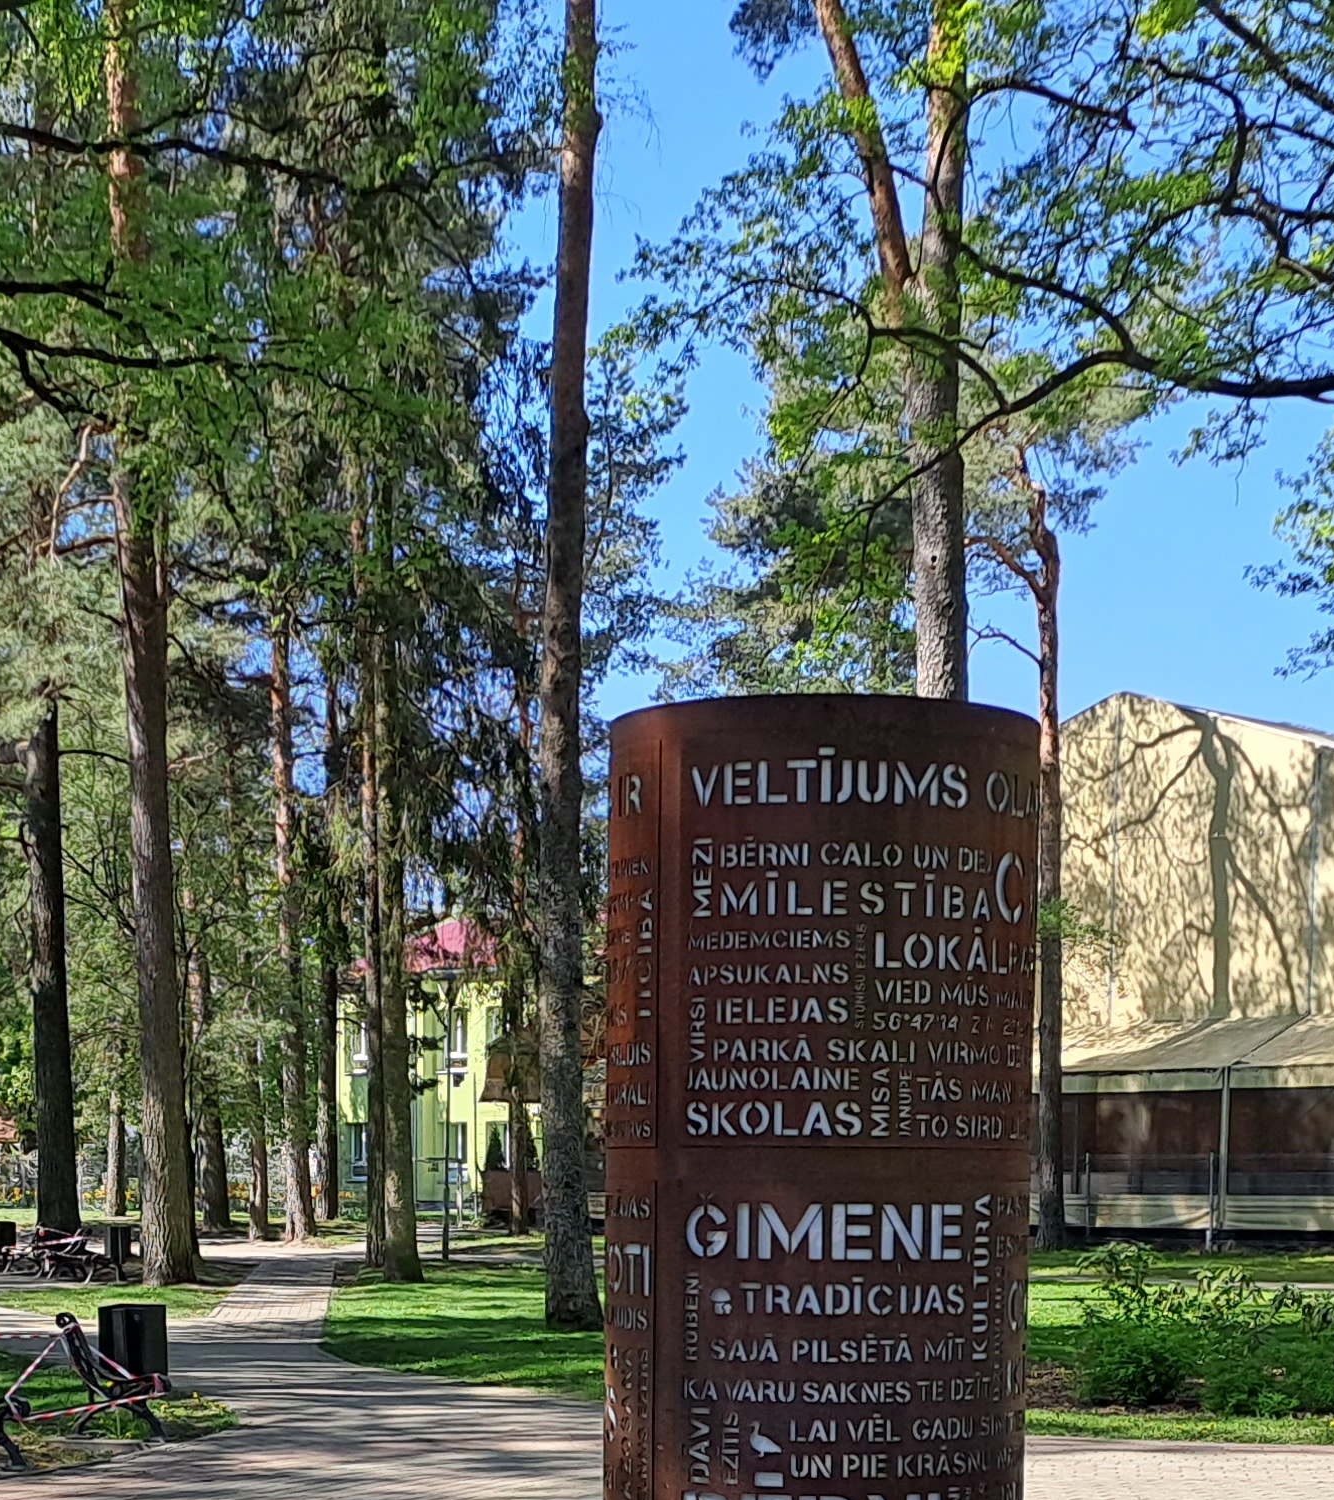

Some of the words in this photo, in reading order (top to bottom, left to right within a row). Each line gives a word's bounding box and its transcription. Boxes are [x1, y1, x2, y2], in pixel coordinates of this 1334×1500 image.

[690, 746, 969, 809] VELTĪJUMS
[719, 835, 811, 868] BĒRNI
[913, 843, 949, 870] UN
[719, 870, 992, 922] MĪLESTĪBA
[687, 929, 852, 951] MEDEMCIEMS
[687, 962, 851, 987] APSUKALNS
[874, 978, 932, 1005] VED
[716, 996, 850, 1025] IELEJAS
[712, 1033, 813, 1063] PARKĀ
[827, 1038, 915, 1063] SKALI
[686, 1066, 860, 1091] JAUNOLAINE
[870, 1067, 891, 1138] MISA
[685, 1100, 864, 1137] SKOLAS
[916, 1114, 949, 1138] TO
[738, 1275, 966, 1316] TRADĪCIJAS
[790, 1332, 914, 1364] PILSĒTĀ
[683, 1376, 718, 1401] KA
[724, 1378, 797, 1403] VARU
[802, 1380, 913, 1404] SAKNES
[917, 1380, 945, 1402] TE
[789, 1418, 838, 1443] LAI
[847, 1412, 902, 1443] VĒL
[912, 1416, 974, 1442] GADU
[789, 1453, 833, 1480] UN
[841, 1452, 889, 1480] PIE
